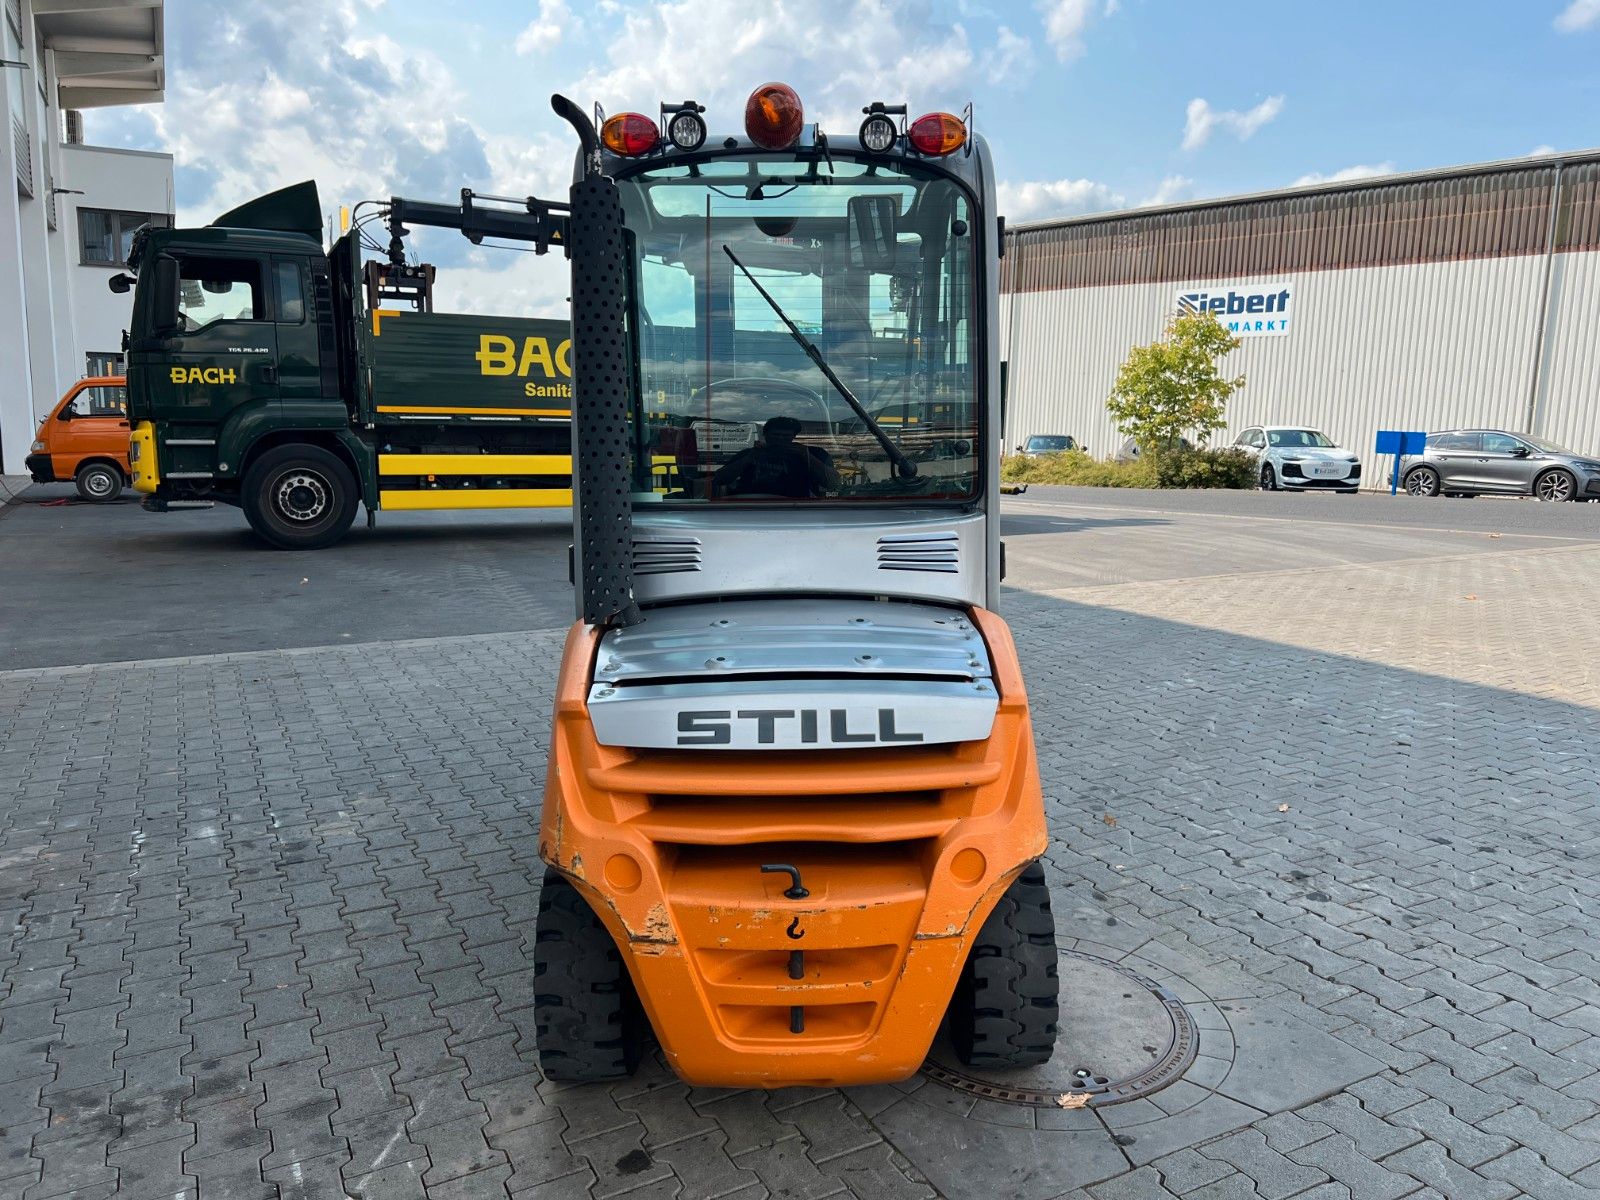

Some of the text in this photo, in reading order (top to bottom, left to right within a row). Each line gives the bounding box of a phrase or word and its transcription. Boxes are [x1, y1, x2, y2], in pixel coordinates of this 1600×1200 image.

[1177, 289, 1290, 316] Siebert
[1228, 320, 1287, 332] MARKT
[170, 367, 236, 384] BACH
[677, 708, 924, 745] STILL
